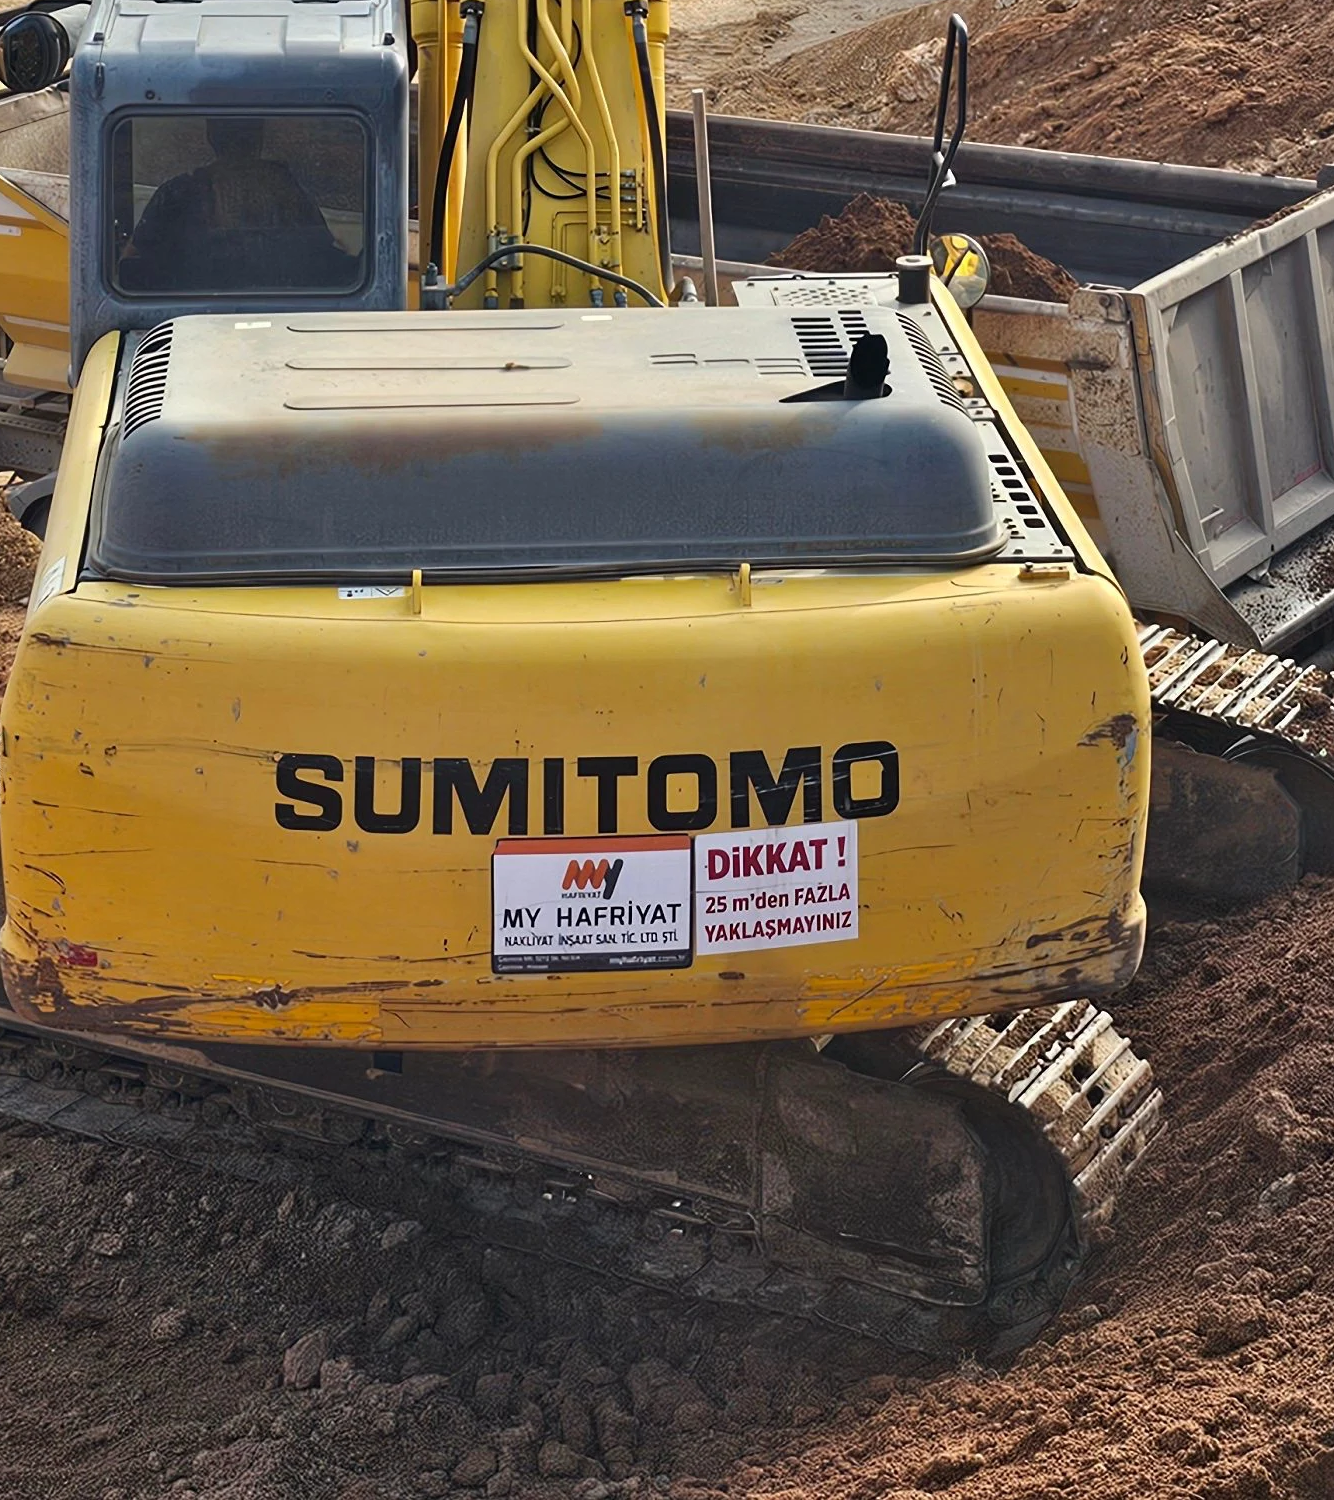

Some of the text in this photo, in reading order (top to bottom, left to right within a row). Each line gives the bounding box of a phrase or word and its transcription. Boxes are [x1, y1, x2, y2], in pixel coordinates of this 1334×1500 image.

[275, 741, 900, 835] SUMITOMO
[707, 838, 828, 880] DİKKAT
[705, 883, 851, 914] 25 m'den FAZLA
[502, 900, 682, 929] MY HAFRİYAT
[705, 911, 852, 943] YAKLAŞMAYINIZ
[504, 933, 553, 947] NAKLİYAT
[558, 933, 593, 947] İNŞAAT
